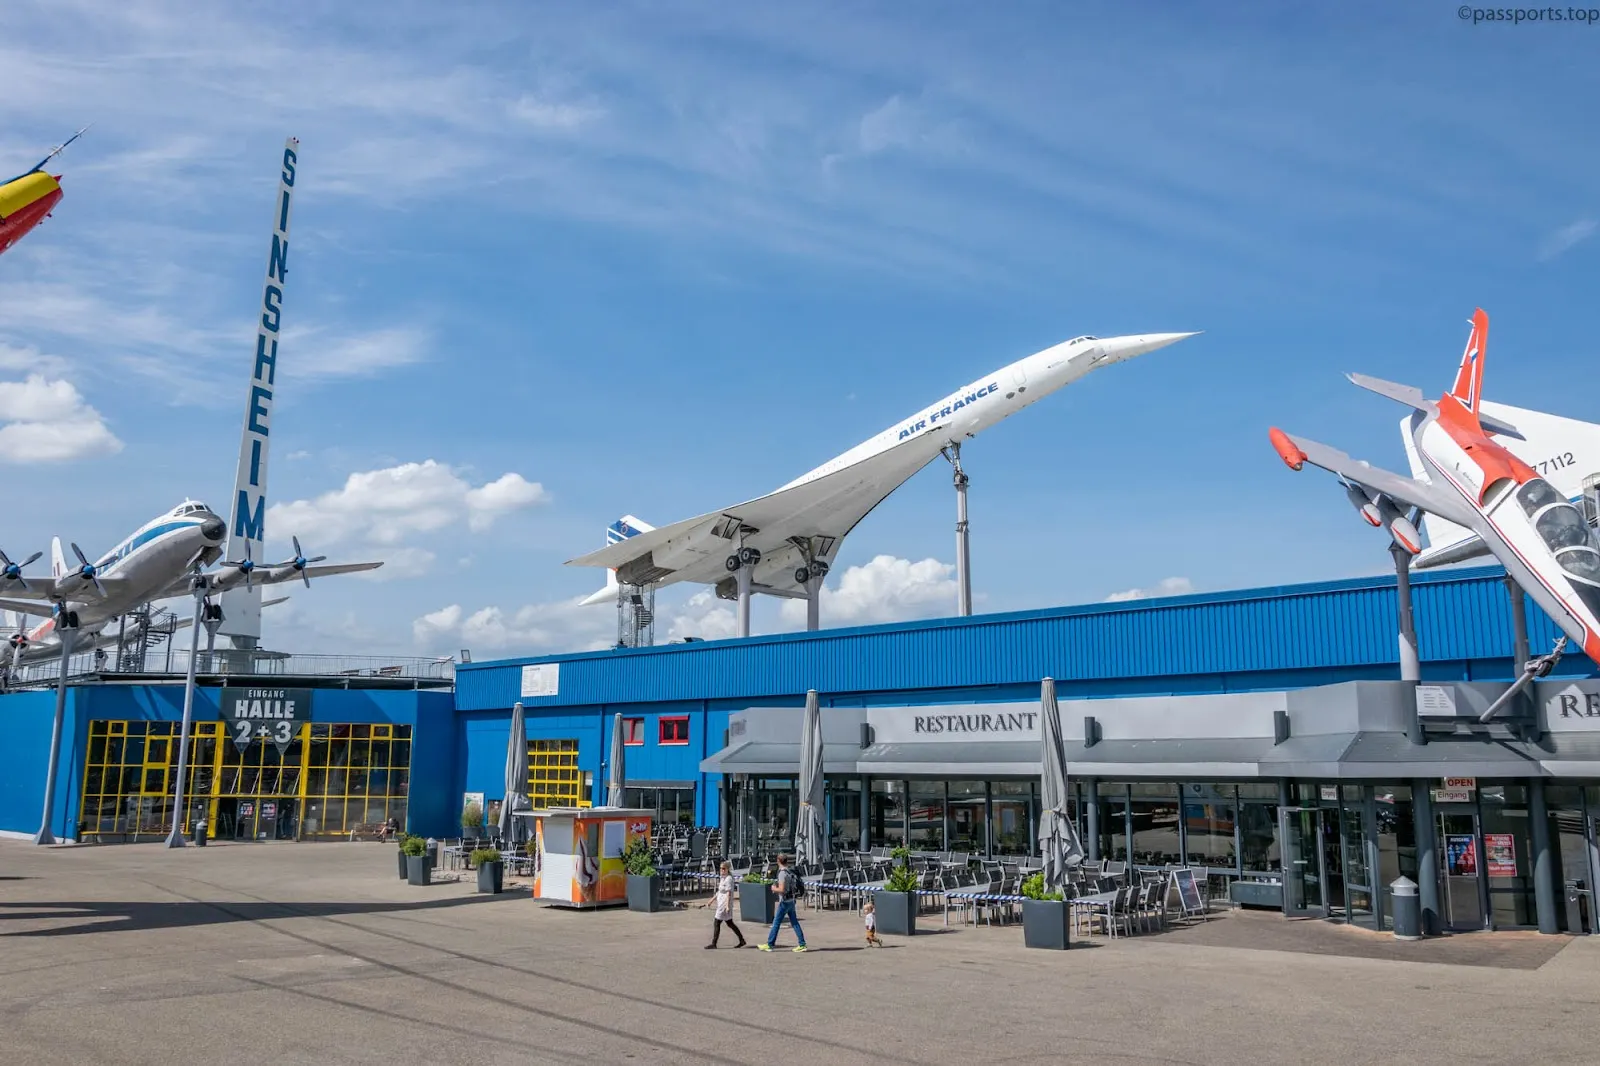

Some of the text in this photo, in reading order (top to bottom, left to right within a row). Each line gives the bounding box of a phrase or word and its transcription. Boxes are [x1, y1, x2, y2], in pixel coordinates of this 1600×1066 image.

[235, 148, 298, 542] SINSHEIM
[898, 382, 999, 441] AIR FRANCE
[248, 689, 285, 698] EINGANG
[234, 699, 296, 719] HALLE
[914, 712, 1038, 734] RESTAURANT
[1447, 778, 1474, 787] OPEN
[1437, 791, 1467, 800] Eingang
